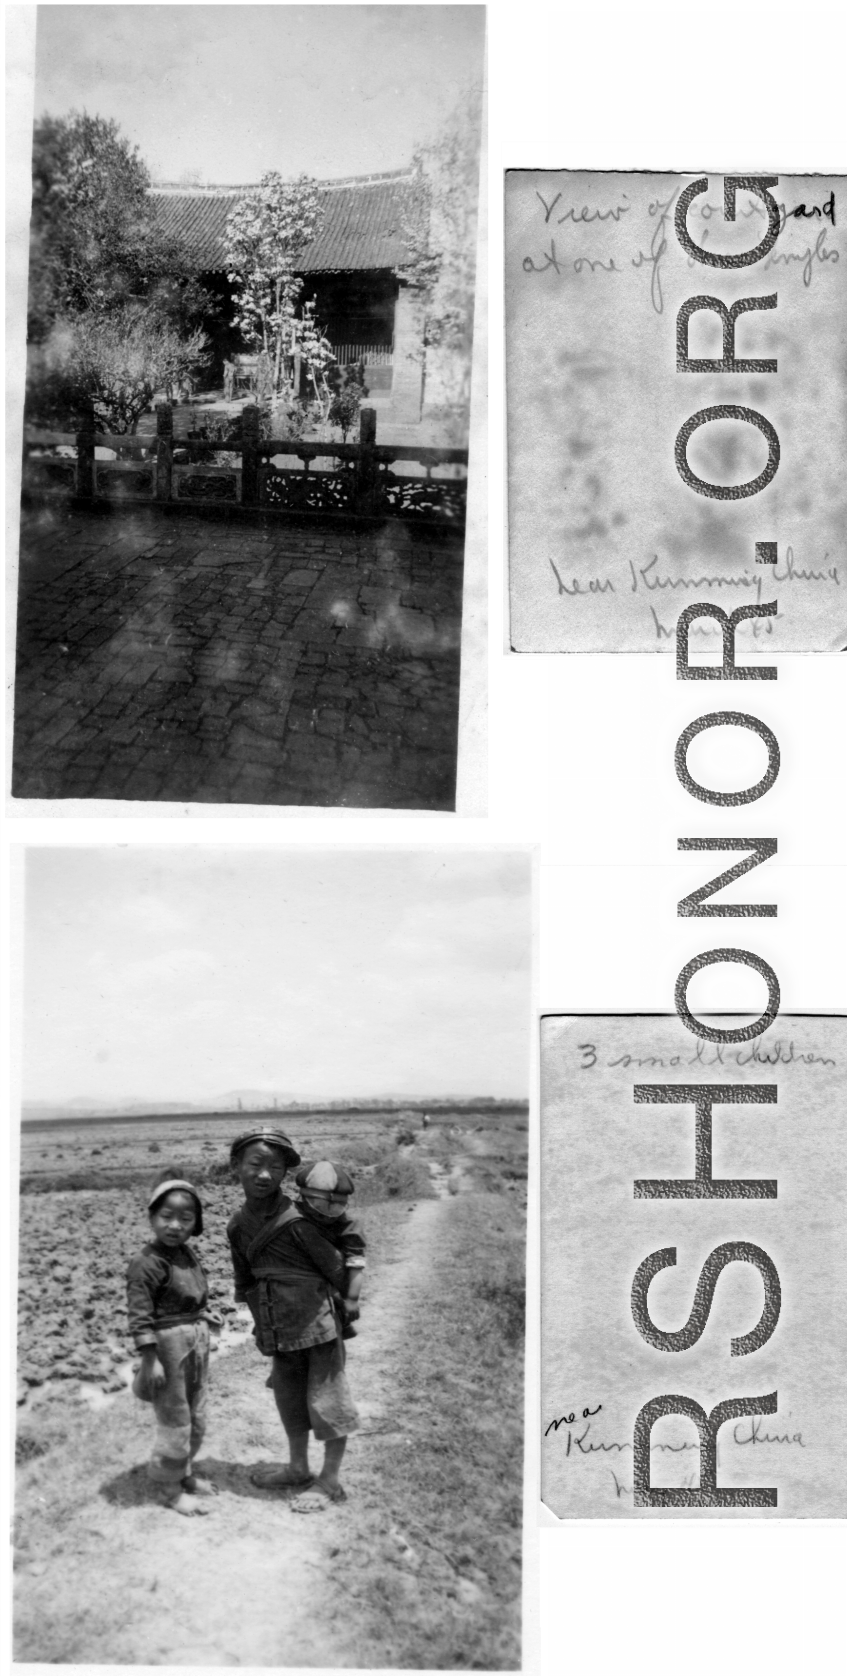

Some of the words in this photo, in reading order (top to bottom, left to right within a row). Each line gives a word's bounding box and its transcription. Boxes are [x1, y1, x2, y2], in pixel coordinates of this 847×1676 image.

[536, 190, 629, 224] View
[522, 238, 565, 275] at
[571, 256, 618, 273] one
[771, 545, 841, 586] China
[577, 1043, 599, 1070] 3
[607, 1038, 724, 1069] small
[735, 1038, 838, 1067] children
[732, 1411, 807, 1449] China
